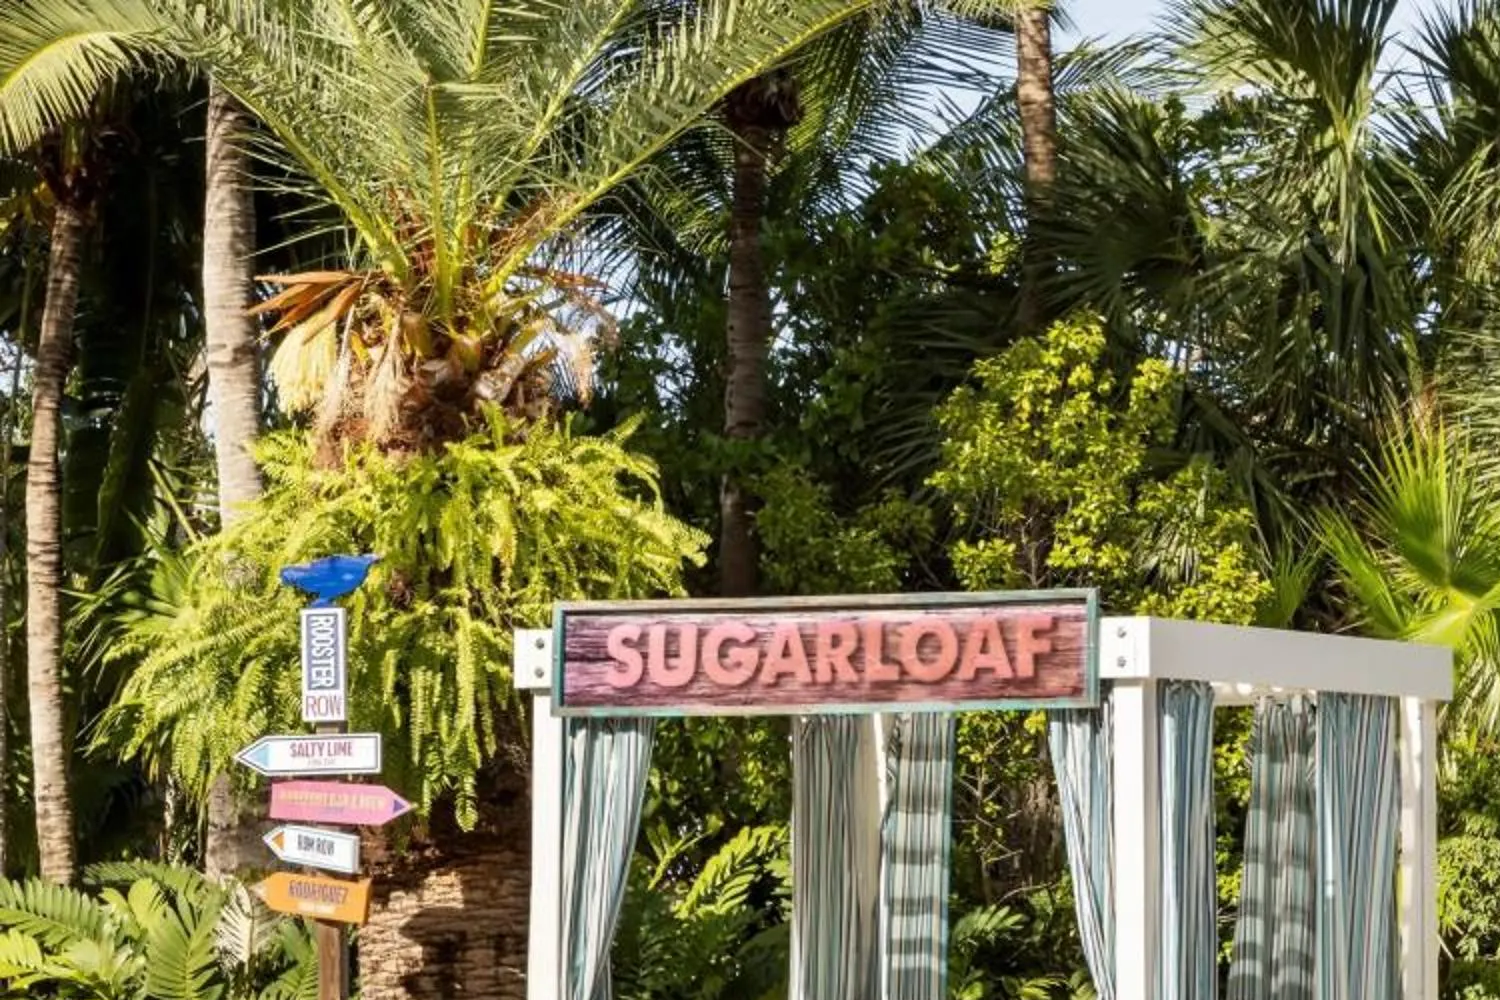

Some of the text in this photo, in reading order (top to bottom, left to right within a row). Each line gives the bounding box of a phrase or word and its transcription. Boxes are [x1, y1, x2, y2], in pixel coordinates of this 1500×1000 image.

[311, 616, 335, 688] ROOSTER
[606, 613, 1057, 688] SUGARLOAF
[306, 695, 342, 717] ROW
[289, 741, 352, 757] SALTY LIME
